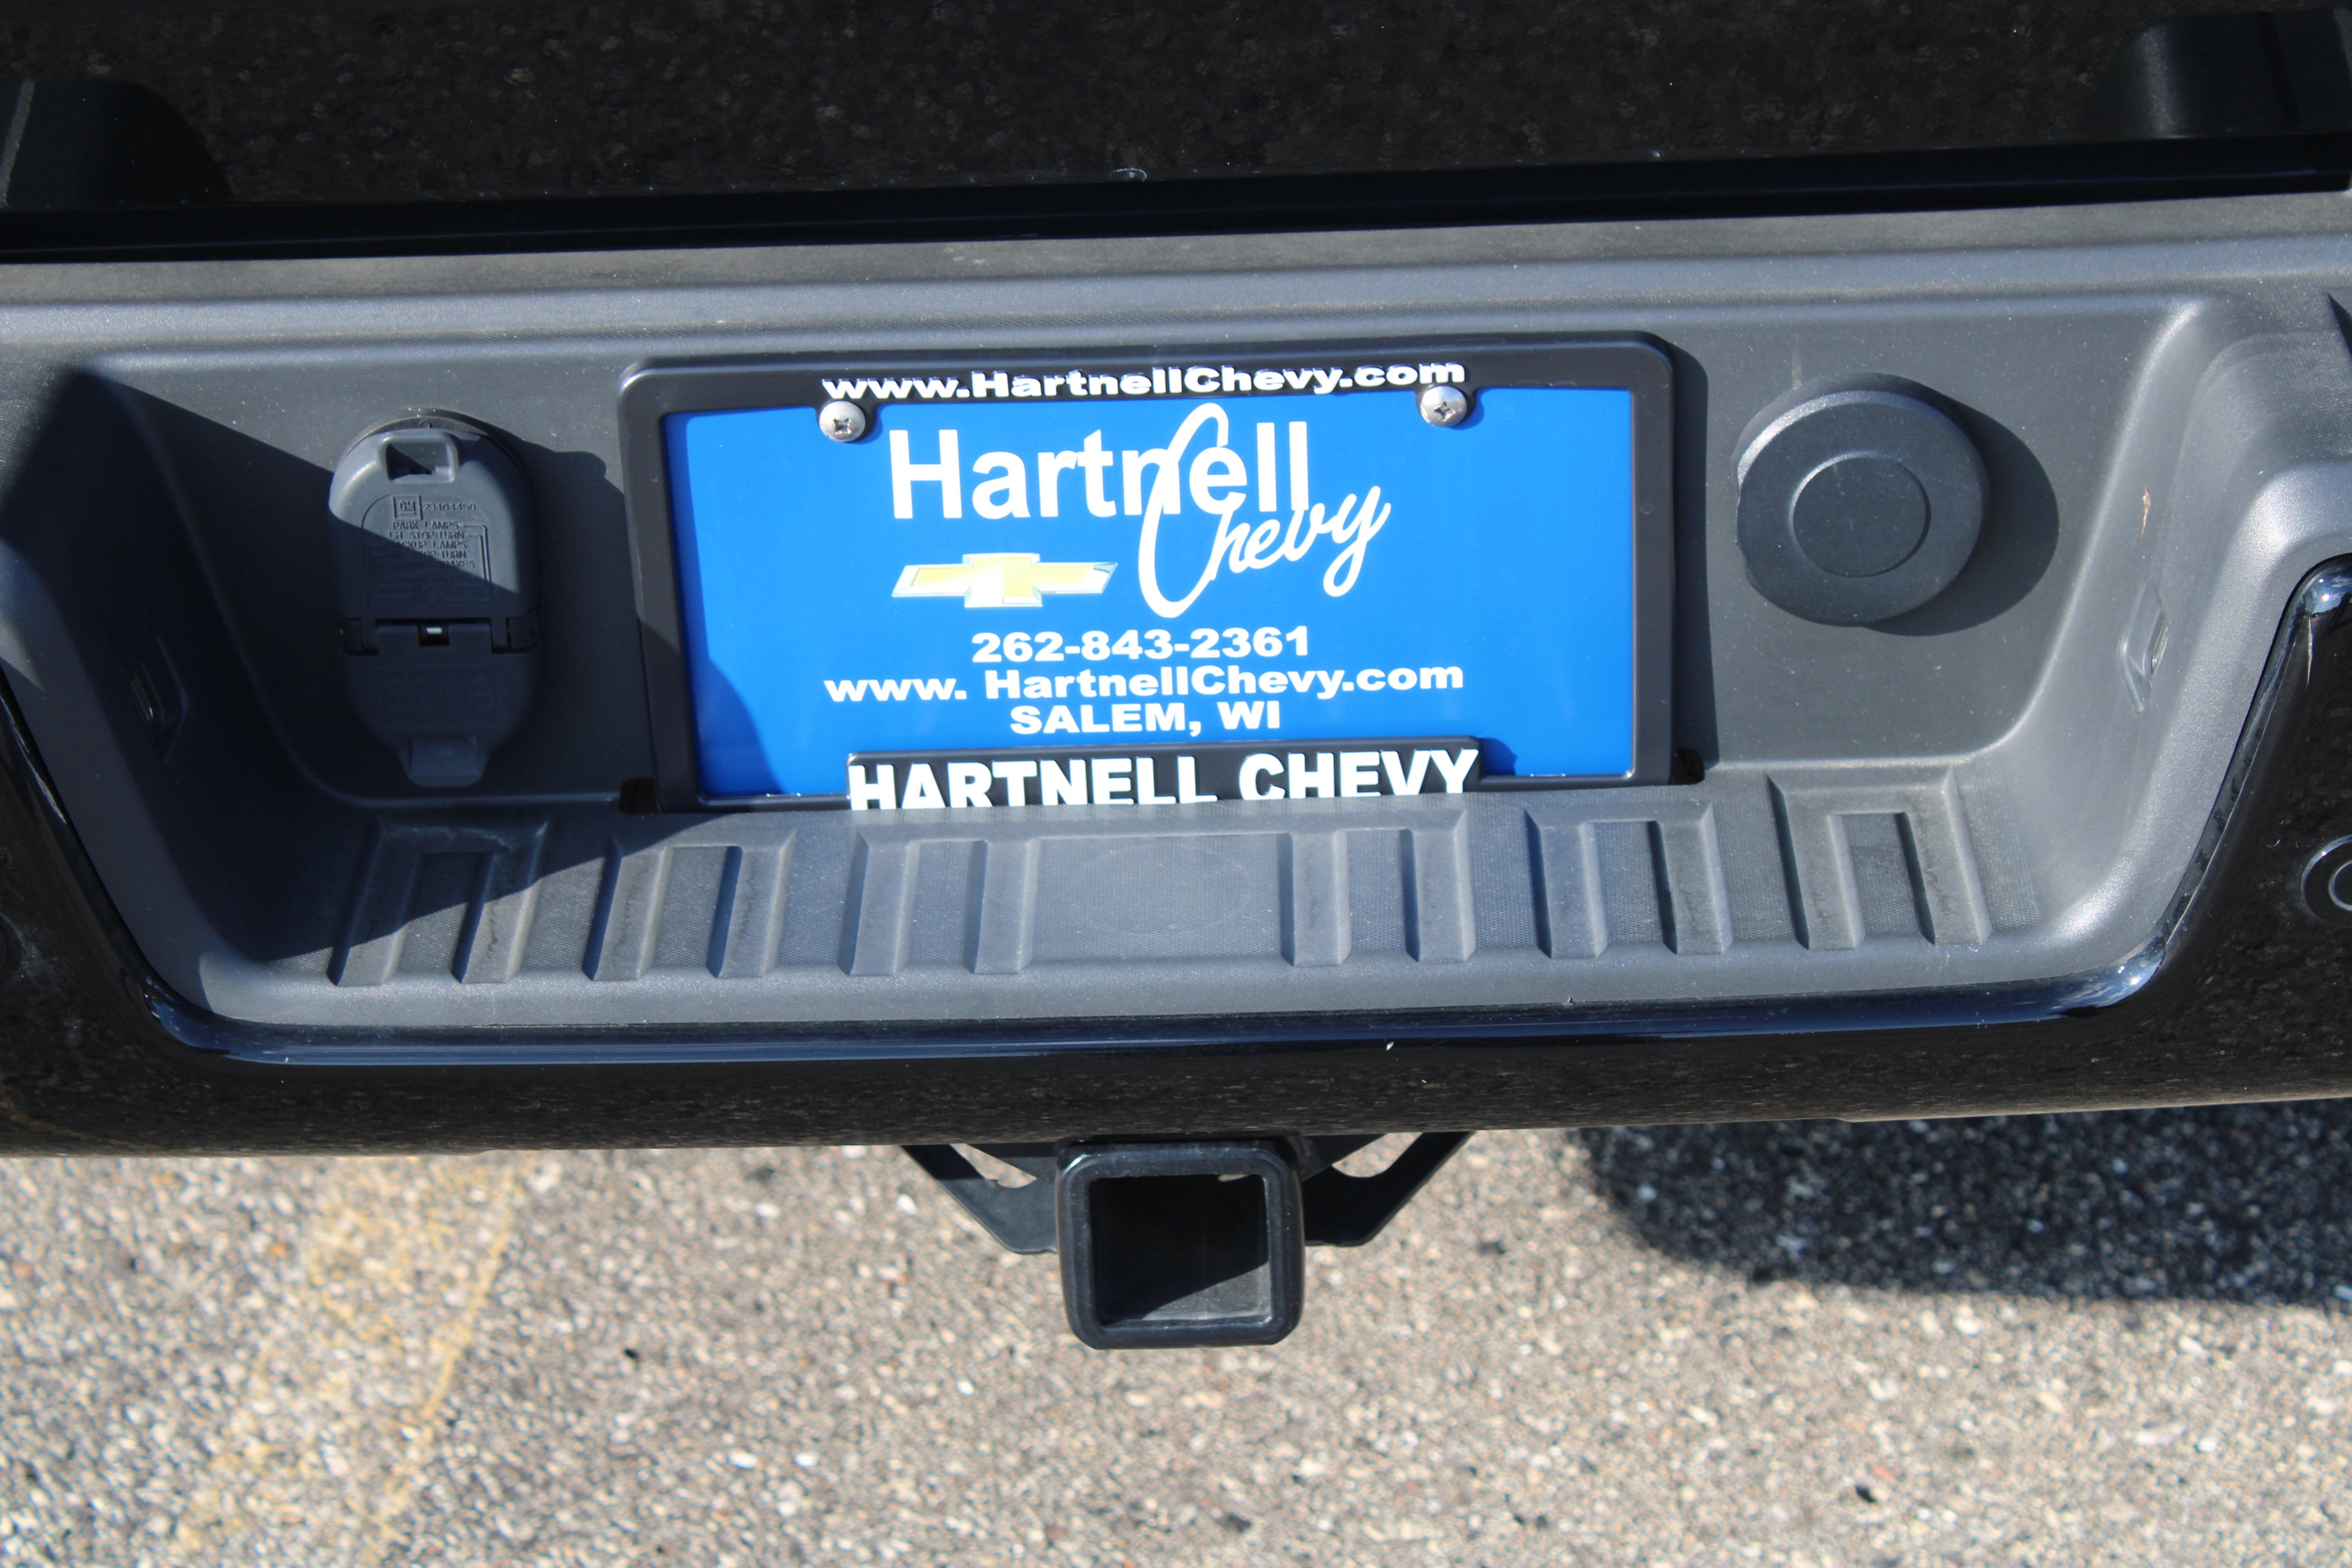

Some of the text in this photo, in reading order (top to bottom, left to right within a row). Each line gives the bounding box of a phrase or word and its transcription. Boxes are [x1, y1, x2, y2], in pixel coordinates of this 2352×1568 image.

[822, 363, 1466, 399] www.HartnellChevy.com
[889, 421, 1308, 519] Hartnell
[398, 500, 416, 512] GM
[1138, 403, 1391, 618] Chevy
[392, 521, 459, 530] PARK LAMPS
[410, 530, 465, 539] STOP/TURN
[433, 541, 467, 549] LAMPS
[972, 626, 1307, 662] 262-843-2361
[824, 665, 1463, 702] www. HartnellChevy.com
[1011, 700, 1280, 737] SALEM, WI
[848, 748, 1479, 811] HARTNELL CHEVY
